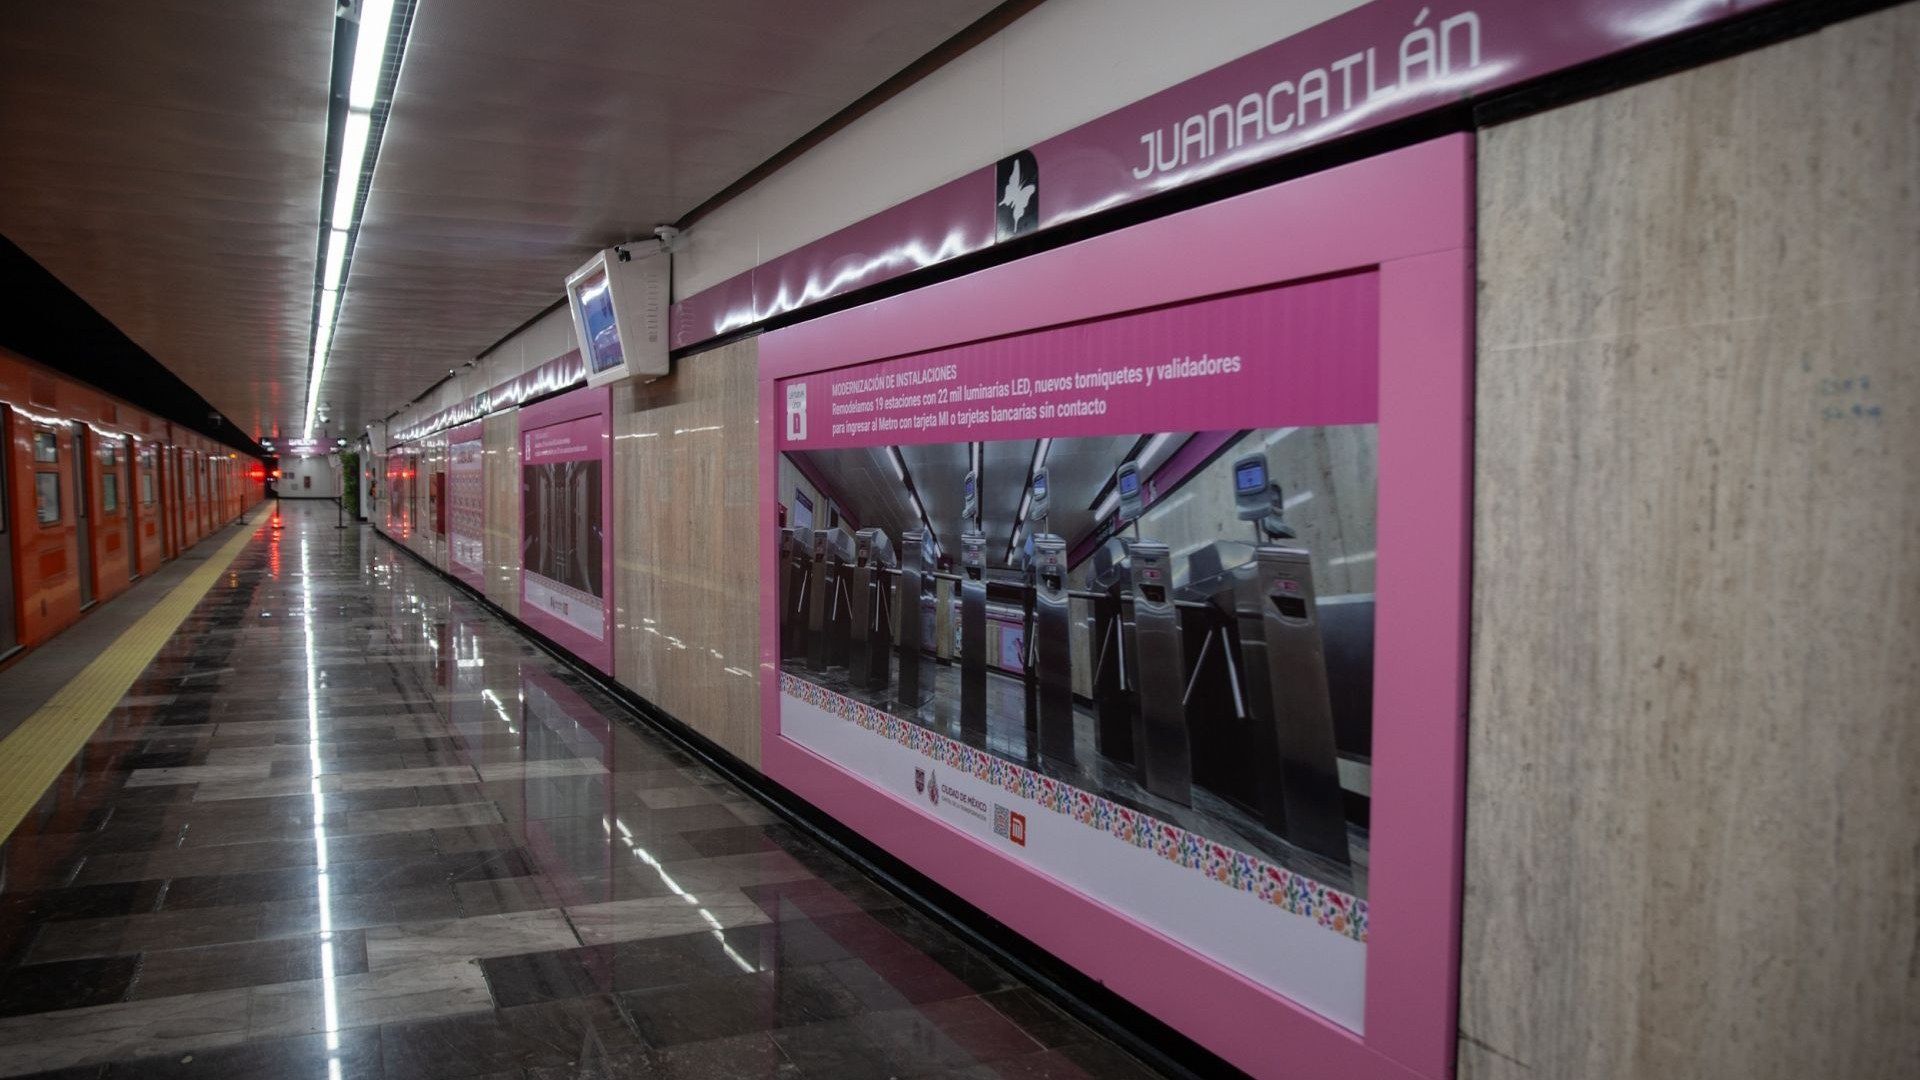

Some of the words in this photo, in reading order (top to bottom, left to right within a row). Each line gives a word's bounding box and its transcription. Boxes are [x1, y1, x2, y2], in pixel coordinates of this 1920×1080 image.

[1133, 7, 1480, 179] JUANACATLÁN
[832, 374, 884, 396] MODERNIZACIÓN
[886, 374, 895, 389] DE
[896, 364, 957, 388] INSTALACIONES
[832, 400, 874, 415] Remodelamos
[876, 397, 883, 411] 19
[885, 394, 921, 410] estaciones
[922, 393, 936, 405] con
[938, 388, 948, 404] 22
[950, 385, 962, 403] mil
[964, 381, 1010, 401] luminarias
[1012, 378, 1033, 397] LED,
[1034, 376, 1073, 394] nuevos
[1075, 367, 1143, 391] torniquetes
[1146, 366, 1154, 387] y
[1157, 354, 1241, 380] validadores
[832, 423, 845, 437] para
[846, 420, 871, 436] ingresar
[872, 417, 877, 431] al
[879, 416, 898, 431] Metro
[899, 417, 913, 429] con
[914, 413, 938, 431] tarjeta
[939, 411, 949, 426] MI
[951, 413, 956, 425] o
[957, 408, 990, 428] tarjetas
[991, 403, 1037, 422] bancarias
[1039, 401, 1055, 419] sin
[1057, 398, 1107, 418] contacto
[942, 784, 959, 799] CIUDAD
[960, 792, 967, 802] DE
[967, 796, 987, 812] MÉXICO
